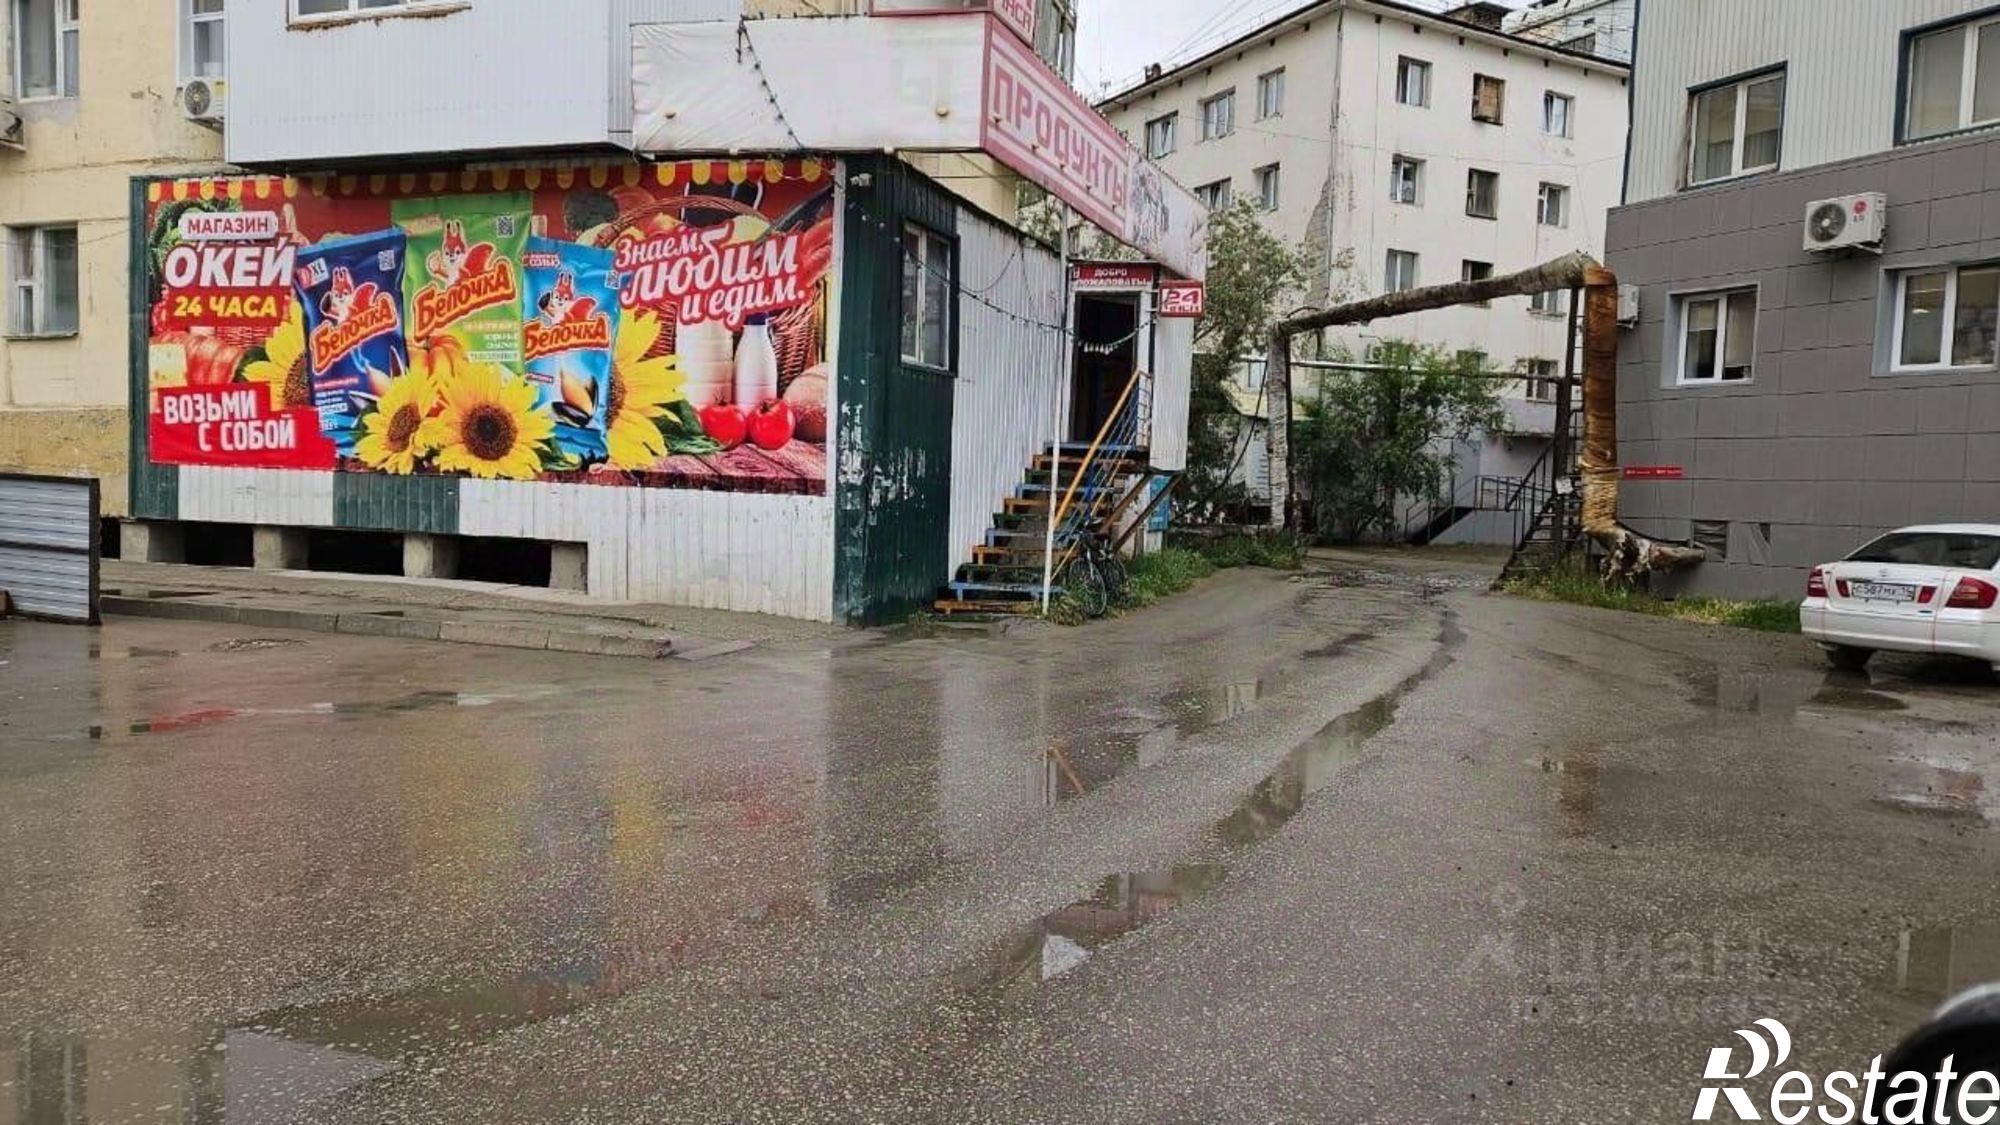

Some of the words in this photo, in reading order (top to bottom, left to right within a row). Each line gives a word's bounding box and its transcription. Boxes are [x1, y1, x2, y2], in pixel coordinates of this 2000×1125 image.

[994, 64, 1127, 207] ПРОДУКТЫ
[187, 217, 269, 234] МАГАЗИН
[616, 236, 703, 268] Знаем,
[621, 227, 798, 303] любим
[1094, 267, 1128, 277] ДОБРО
[174, 296, 202, 317] 24
[209, 296, 278, 317] ЧАСА
[417, 265, 514, 334] Белочка
[684, 293, 704, 320] и
[710, 276, 805, 325] едим.
[1167, 289, 1200, 304] 24
[313, 299, 396, 368] Белочка
[525, 316, 609, 354] Белочка
[163, 391, 258, 424] ВОЗЬМИ
[198, 424, 212, 451] С
[220, 414, 295, 450] СОБОЙ
